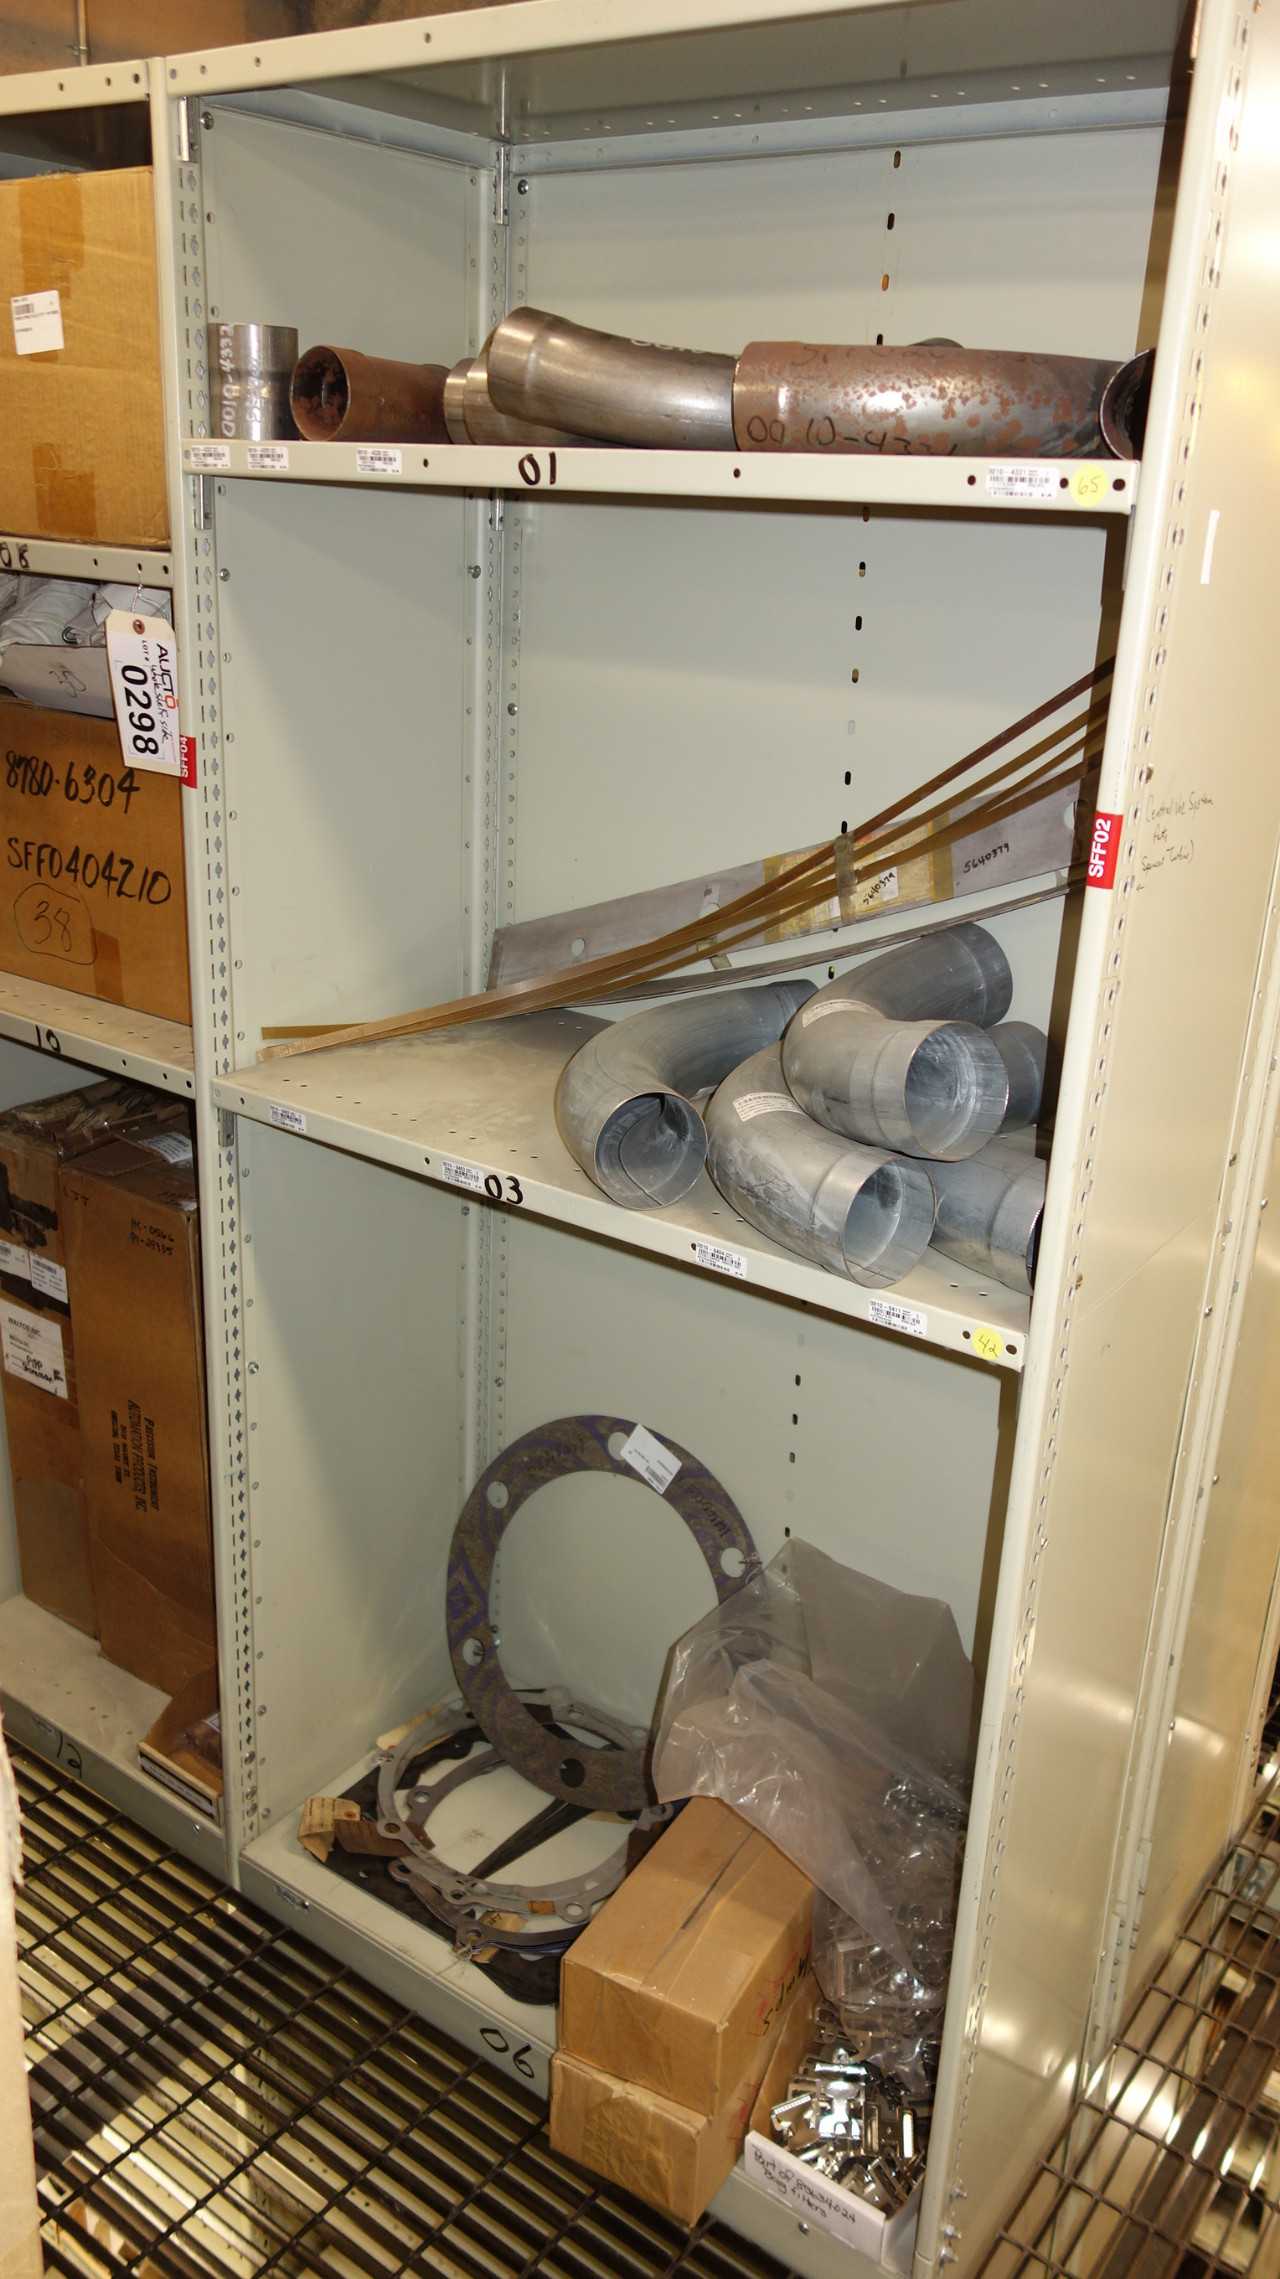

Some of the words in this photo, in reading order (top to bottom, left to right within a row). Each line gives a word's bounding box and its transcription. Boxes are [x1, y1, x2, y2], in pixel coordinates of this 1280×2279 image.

[517, 451, 557, 486] 01
[1077, 474, 1102, 496] 65
[121, 664, 160, 755] 0298
[1088, 818, 1112, 878] SFF02
[33, 900, 73, 953] 38
[35, 1023, 62, 1054] 10
[484, 1173, 524, 1205] 03
[977, 1334, 999, 1358] 42
[479, 2027, 536, 2079] 06
